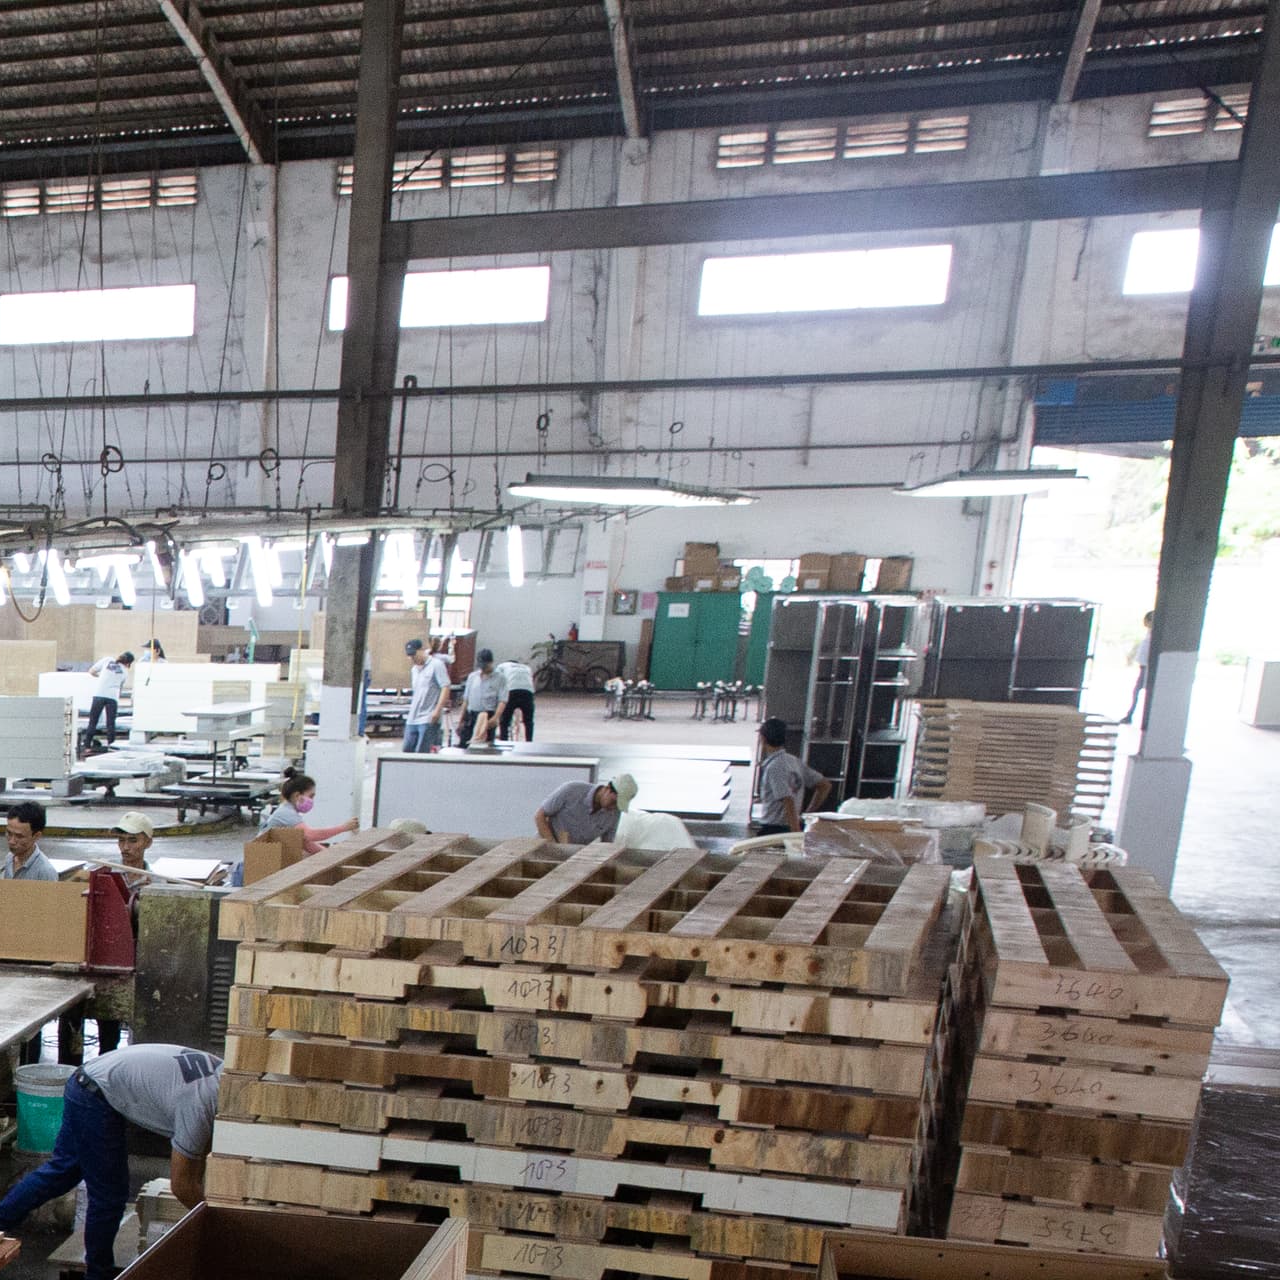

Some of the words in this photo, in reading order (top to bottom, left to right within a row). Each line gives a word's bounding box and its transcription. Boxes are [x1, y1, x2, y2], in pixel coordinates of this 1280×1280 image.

[500, 935, 557, 956] 1073
[507, 979, 553, 1002] 1073
[513, 1243, 564, 1271] 1073
